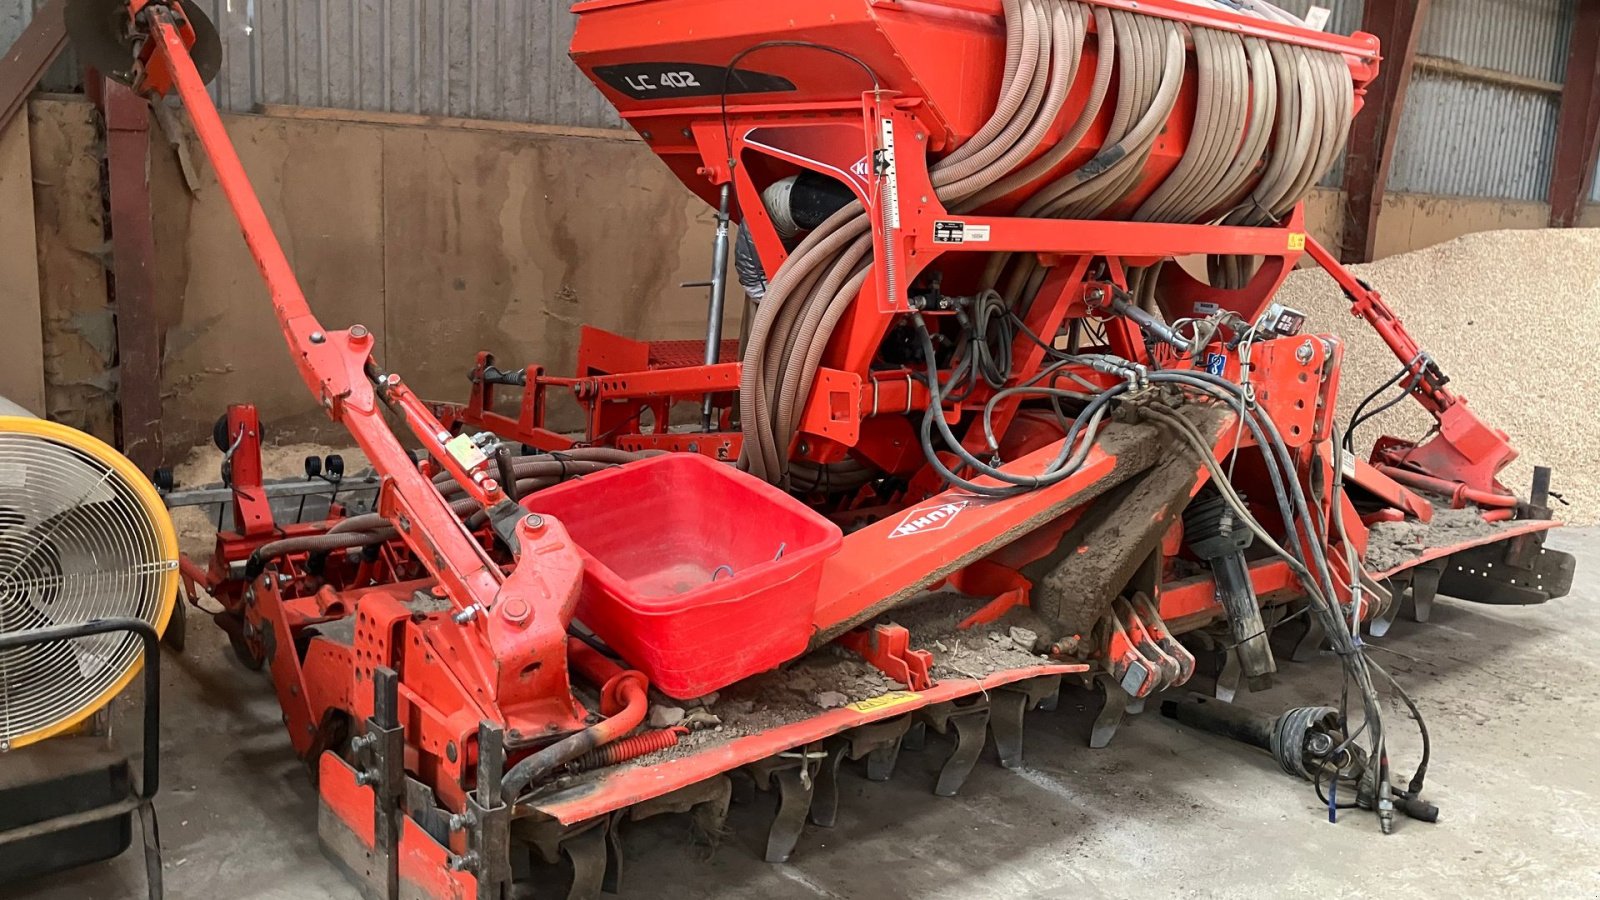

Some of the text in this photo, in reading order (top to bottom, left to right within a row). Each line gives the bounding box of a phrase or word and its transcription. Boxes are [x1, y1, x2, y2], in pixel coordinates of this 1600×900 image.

[624, 71, 701, 90] LC 402
[897, 504, 960, 535] KUHN
